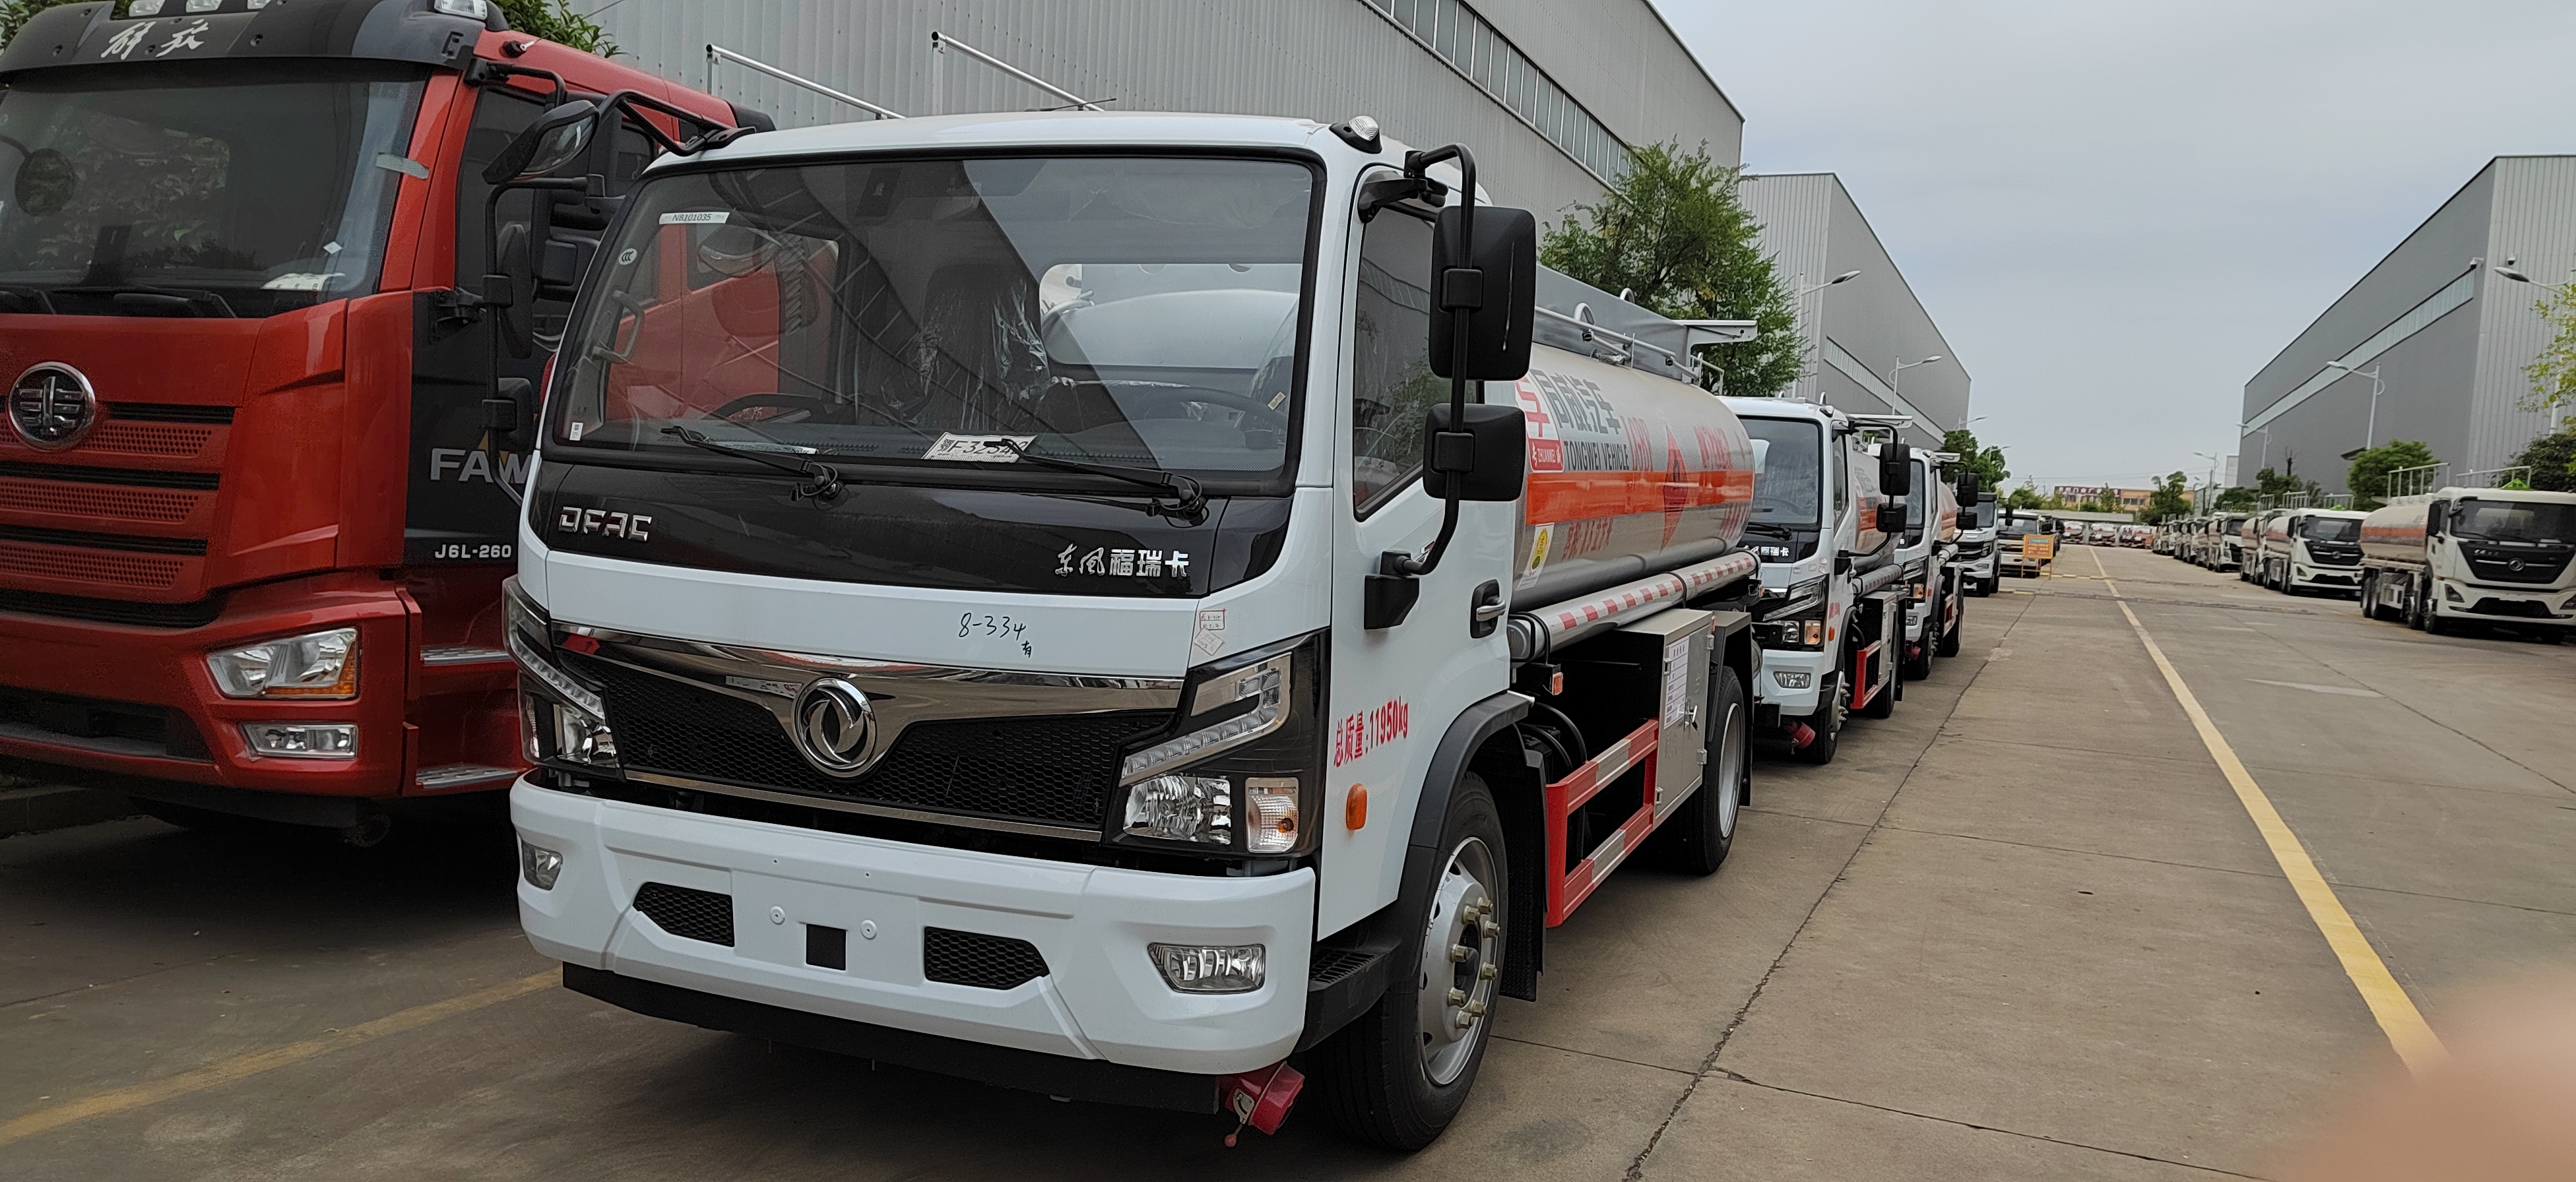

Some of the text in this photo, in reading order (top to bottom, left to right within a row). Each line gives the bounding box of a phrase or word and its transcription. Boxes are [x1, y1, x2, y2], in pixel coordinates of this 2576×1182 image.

[100, 18, 209, 61] 解放
[672, 213, 712, 222] NB101035
[430, 448, 532, 484] FAW
[1563, 441, 1601, 470] TONGWEI
[1601, 443, 1630, 471] VEHICLE
[558, 507, 653, 542] DFAC
[434, 544, 511, 559] J6L-260
[1055, 543, 1189, 578] 东风福瑞卡
[959, 612, 1026, 641] 8-334
[1334, 695, 1408, 767] 总质量:11950kg
